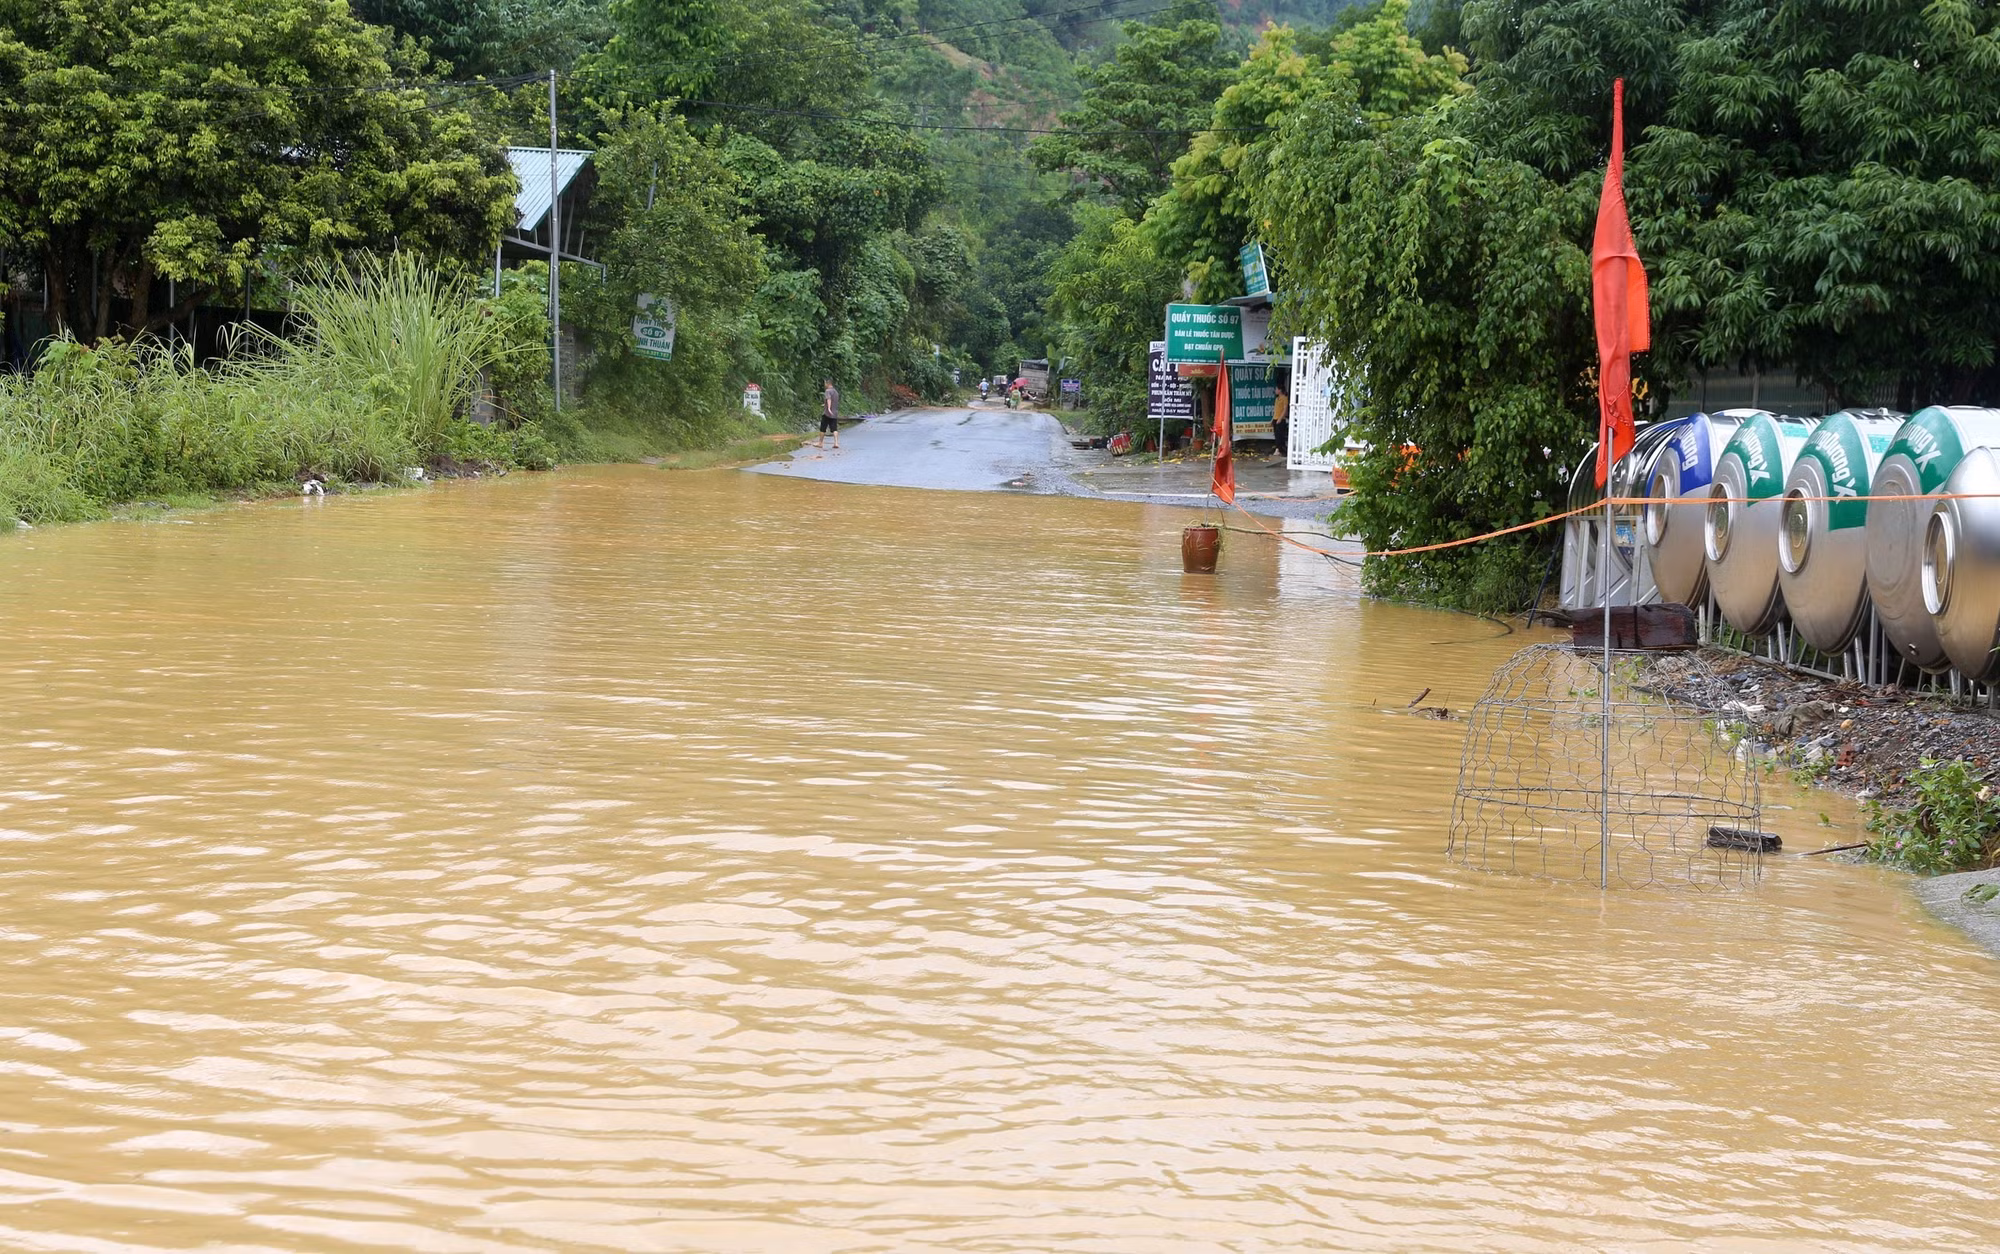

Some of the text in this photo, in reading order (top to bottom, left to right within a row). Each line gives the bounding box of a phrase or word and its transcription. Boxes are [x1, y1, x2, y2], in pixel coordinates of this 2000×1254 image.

[1193, 311, 1217, 324] THUỐC
[1218, 312, 1229, 324] SỐ
[1230, 315, 1239, 324] 97
